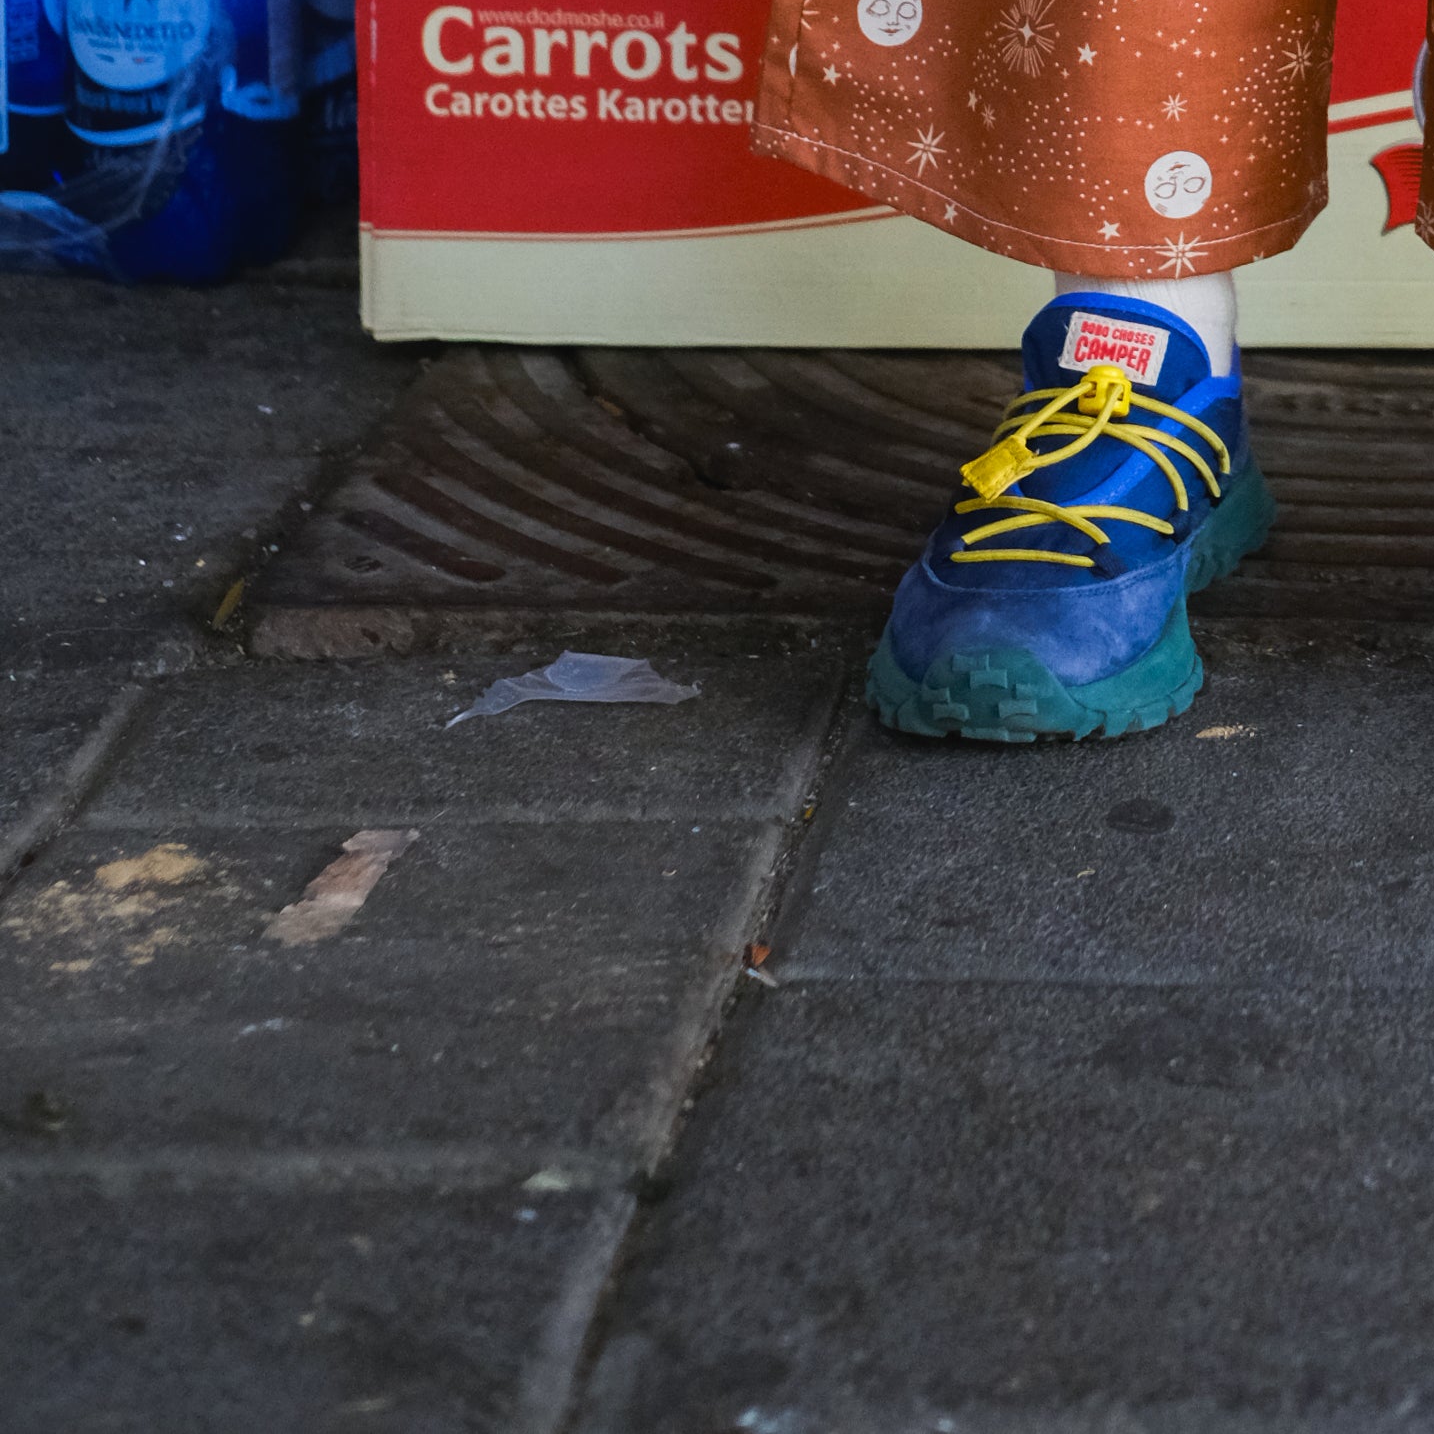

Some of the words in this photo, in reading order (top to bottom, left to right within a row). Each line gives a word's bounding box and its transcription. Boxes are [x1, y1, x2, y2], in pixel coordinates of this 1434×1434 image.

[477, 7, 666, 30] www.dodmoshe.co.il
[421, 4, 744, 83] Carrots
[424, 83, 588, 120] Carottes
[1112, 328, 1157, 347] CHOSES
[1074, 336, 1152, 377] CAMPER
